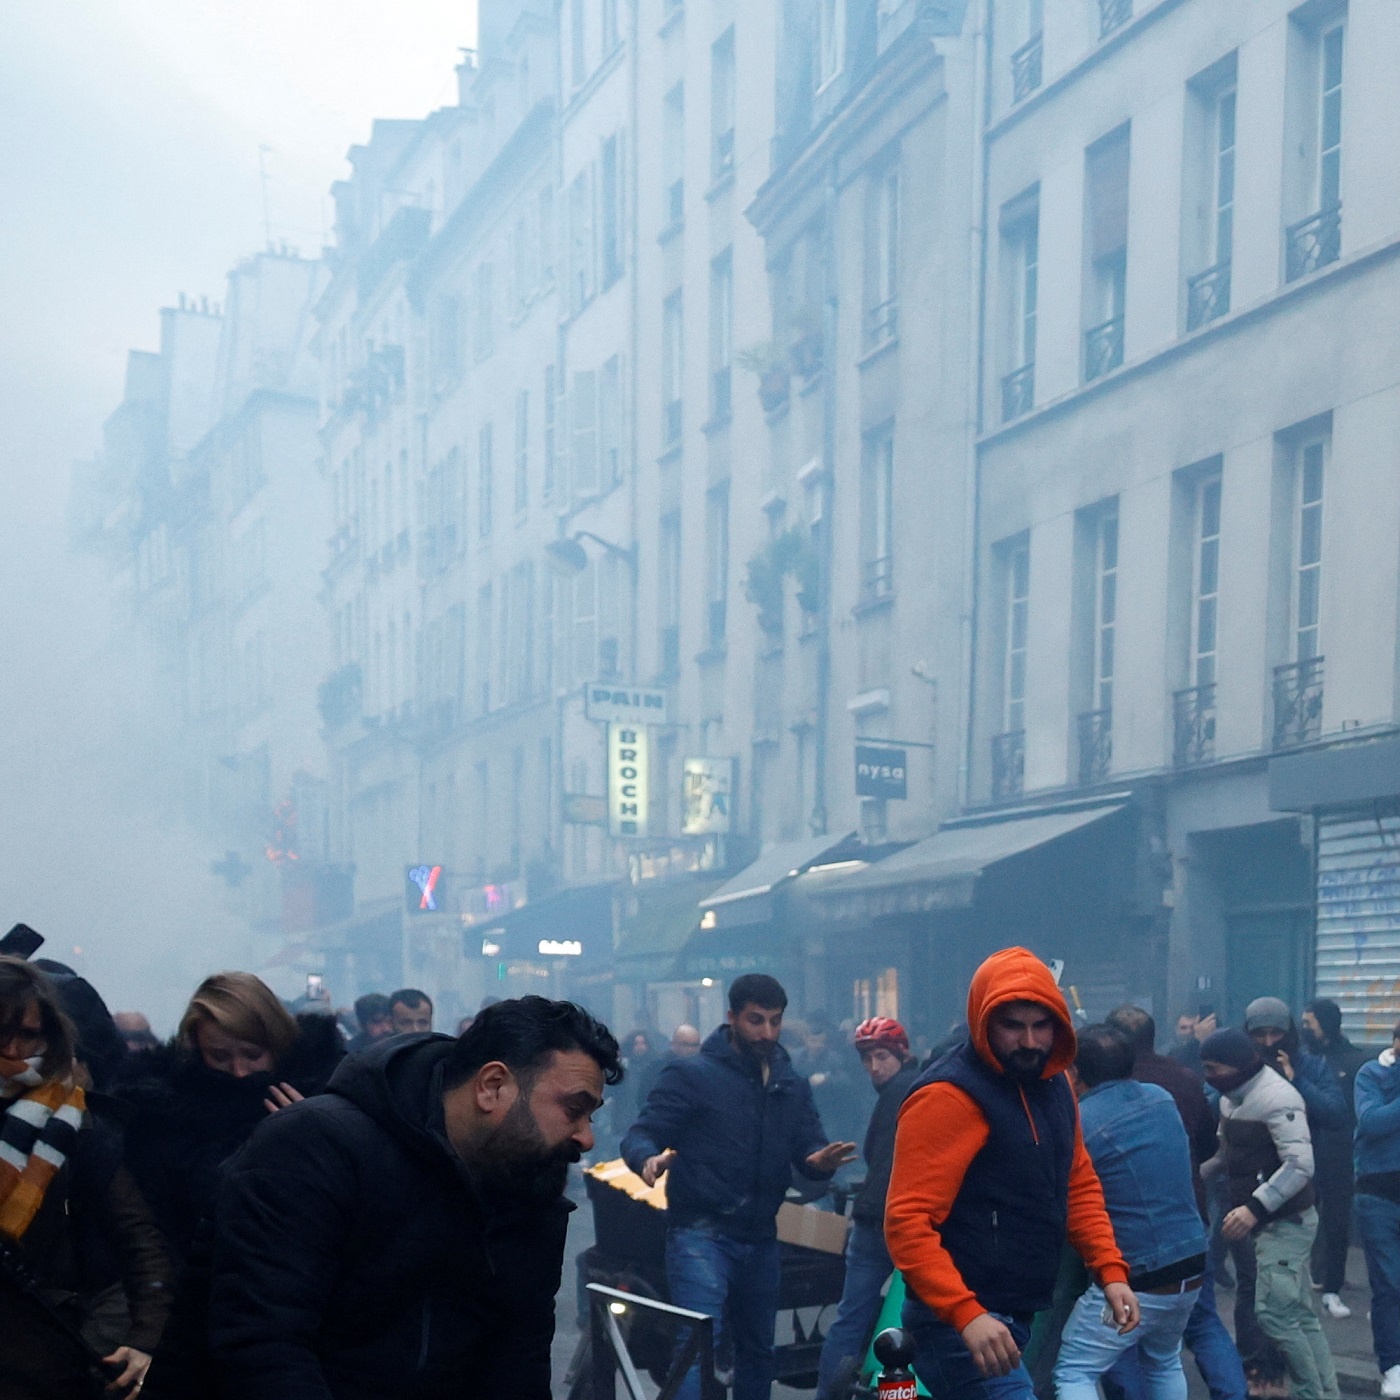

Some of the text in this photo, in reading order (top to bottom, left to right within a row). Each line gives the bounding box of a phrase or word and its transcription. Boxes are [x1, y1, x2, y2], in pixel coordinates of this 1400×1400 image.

[592, 690, 663, 709] PAIN
[857, 763, 904, 780] nysa
[879, 1384, 918, 1400] watch
